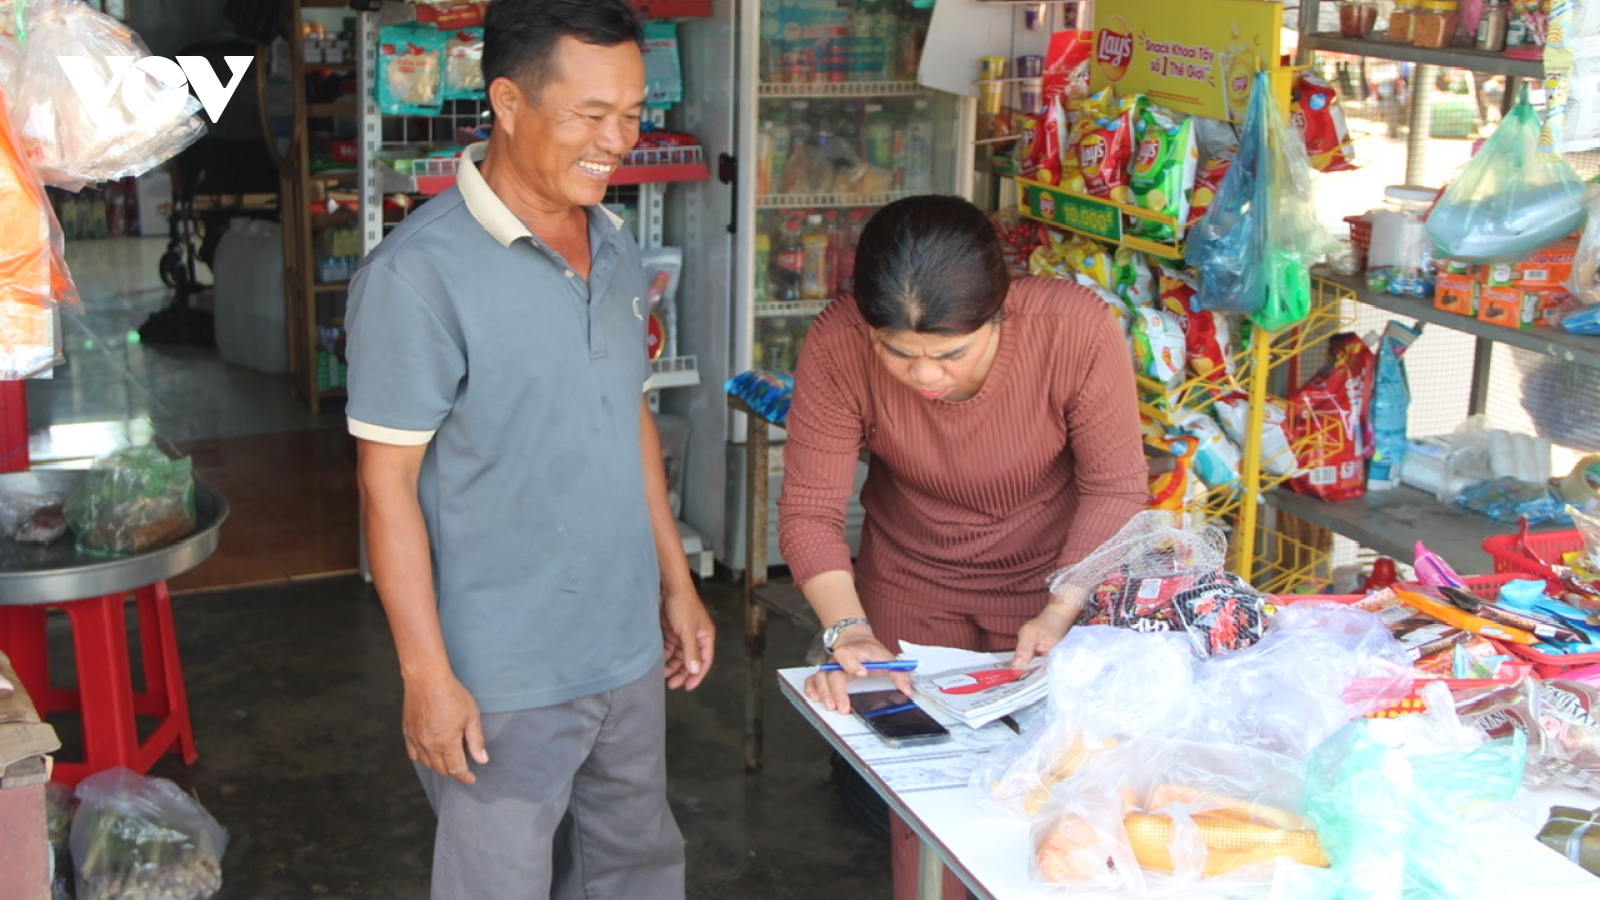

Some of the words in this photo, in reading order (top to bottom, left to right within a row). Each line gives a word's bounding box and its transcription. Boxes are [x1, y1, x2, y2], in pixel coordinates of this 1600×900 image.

[1098, 30, 1132, 66] Lay's
[1144, 39, 1170, 54] Snack
[1171, 43, 1197, 59] Khoai
[1081, 142, 1105, 167] Lay's
